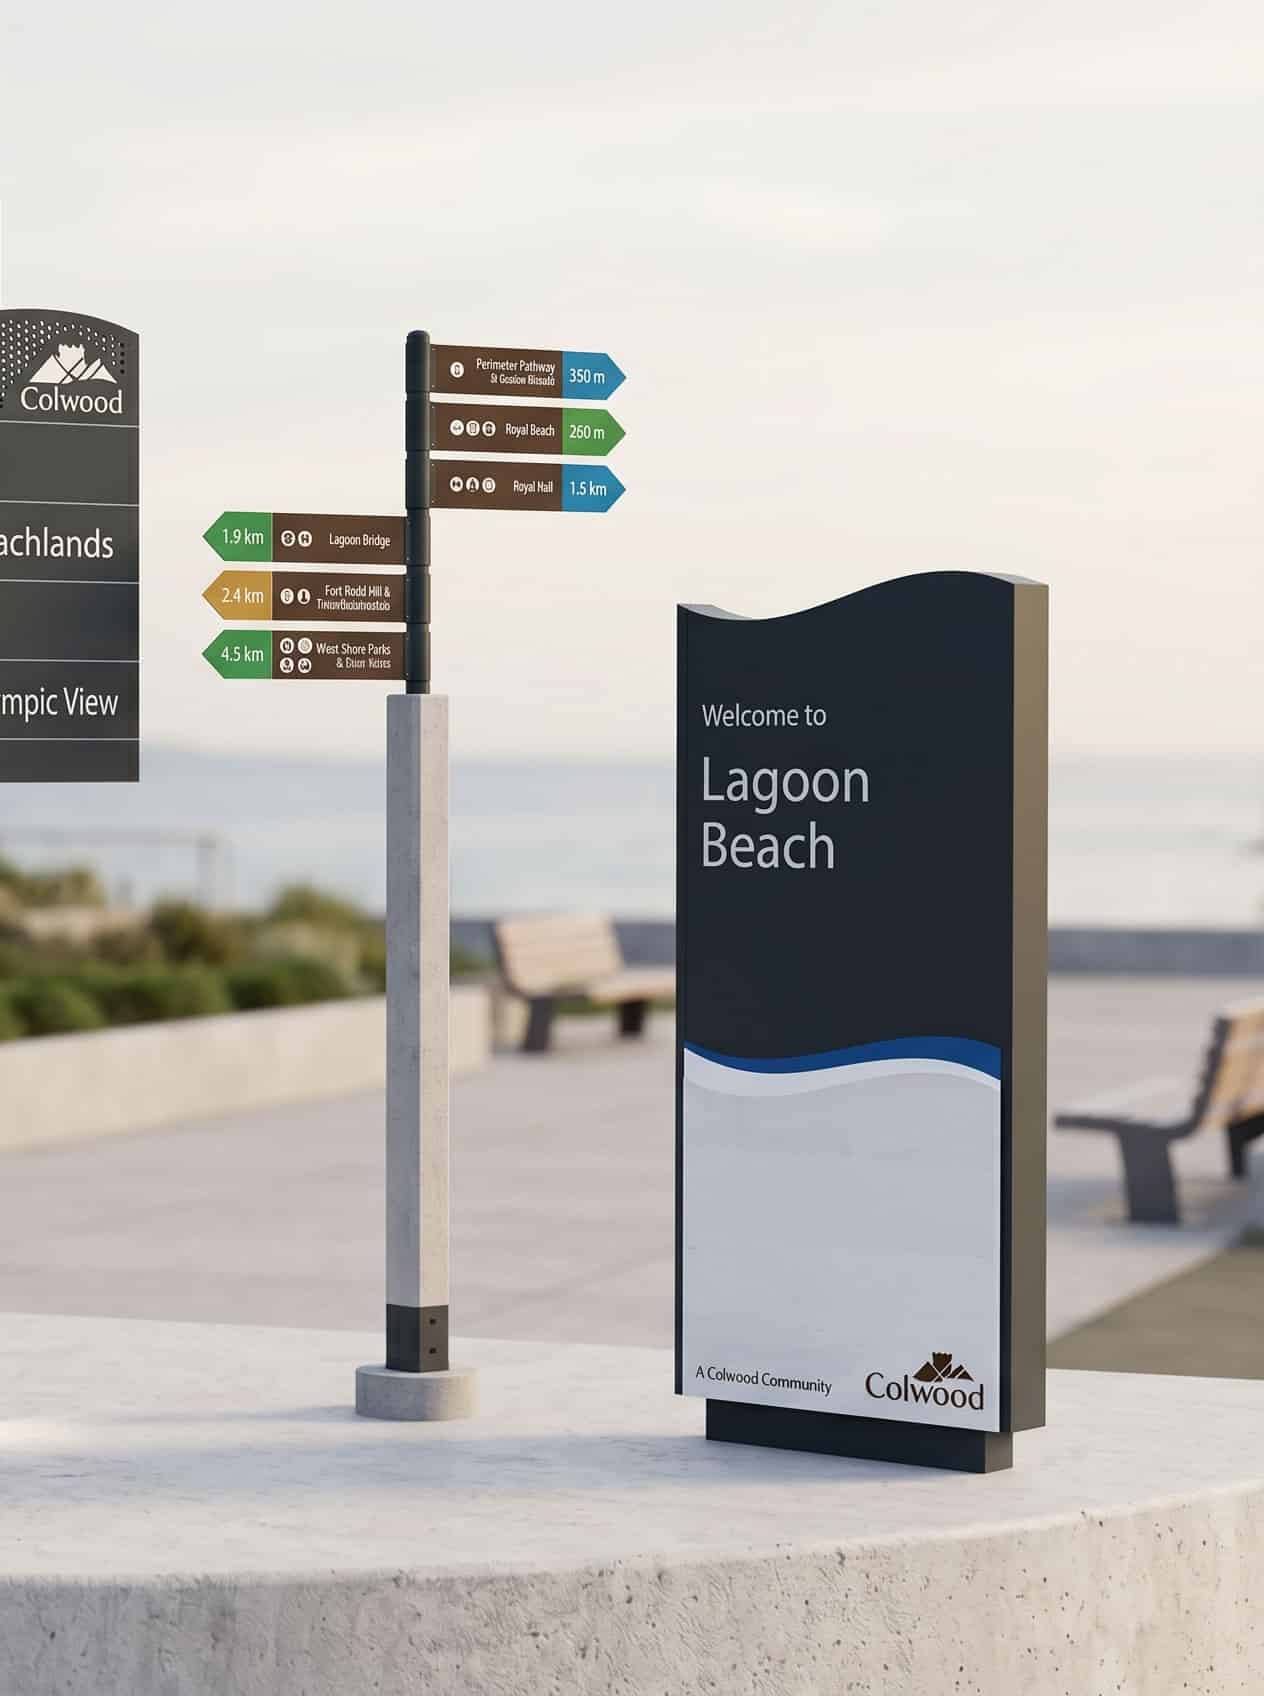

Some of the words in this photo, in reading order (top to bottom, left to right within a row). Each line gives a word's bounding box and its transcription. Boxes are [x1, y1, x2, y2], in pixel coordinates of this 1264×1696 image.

[477, 358, 517, 370] Perimeter
[520, 360, 555, 374] Pathway
[570, 368, 591, 383] 350
[594, 373, 604, 384] m
[21, 386, 122, 413] Colwood
[506, 424, 528, 437] Royal
[531, 425, 554, 436] Beach
[570, 425, 591, 439] 260
[594, 429, 604, 439] m
[514, 480, 534, 494] Royal
[571, 482, 586, 495] 1.5
[590, 482, 606, 496] km
[224, 529, 241, 544] 1.9
[245, 528, 263, 544] km
[330, 533, 360, 547] Lagoon
[363, 535, 390, 549] Bridge
[222, 588, 240, 602] 2.4
[245, 588, 263, 603] km
[326, 585, 342, 596] Fort
[345, 585, 366, 596] Rodd
[384, 586, 390, 597] &
[221, 647, 240, 661] 4.5
[245, 647, 263, 662] km
[317, 643, 338, 654] West
[342, 643, 366, 654] Shore
[368, 644, 390, 655] Parks
[63, 688, 118, 715] View
[702, 704, 798, 726] Welcome
[805, 705, 826, 726] to
[704, 757, 868, 814] Lagoon
[704, 821, 833, 868] Beach
[696, 1366, 704, 1378] A
[707, 1367, 758, 1384] Colwood
[762, 1373, 831, 1397] Community
[866, 1371, 984, 1410] Colwood
